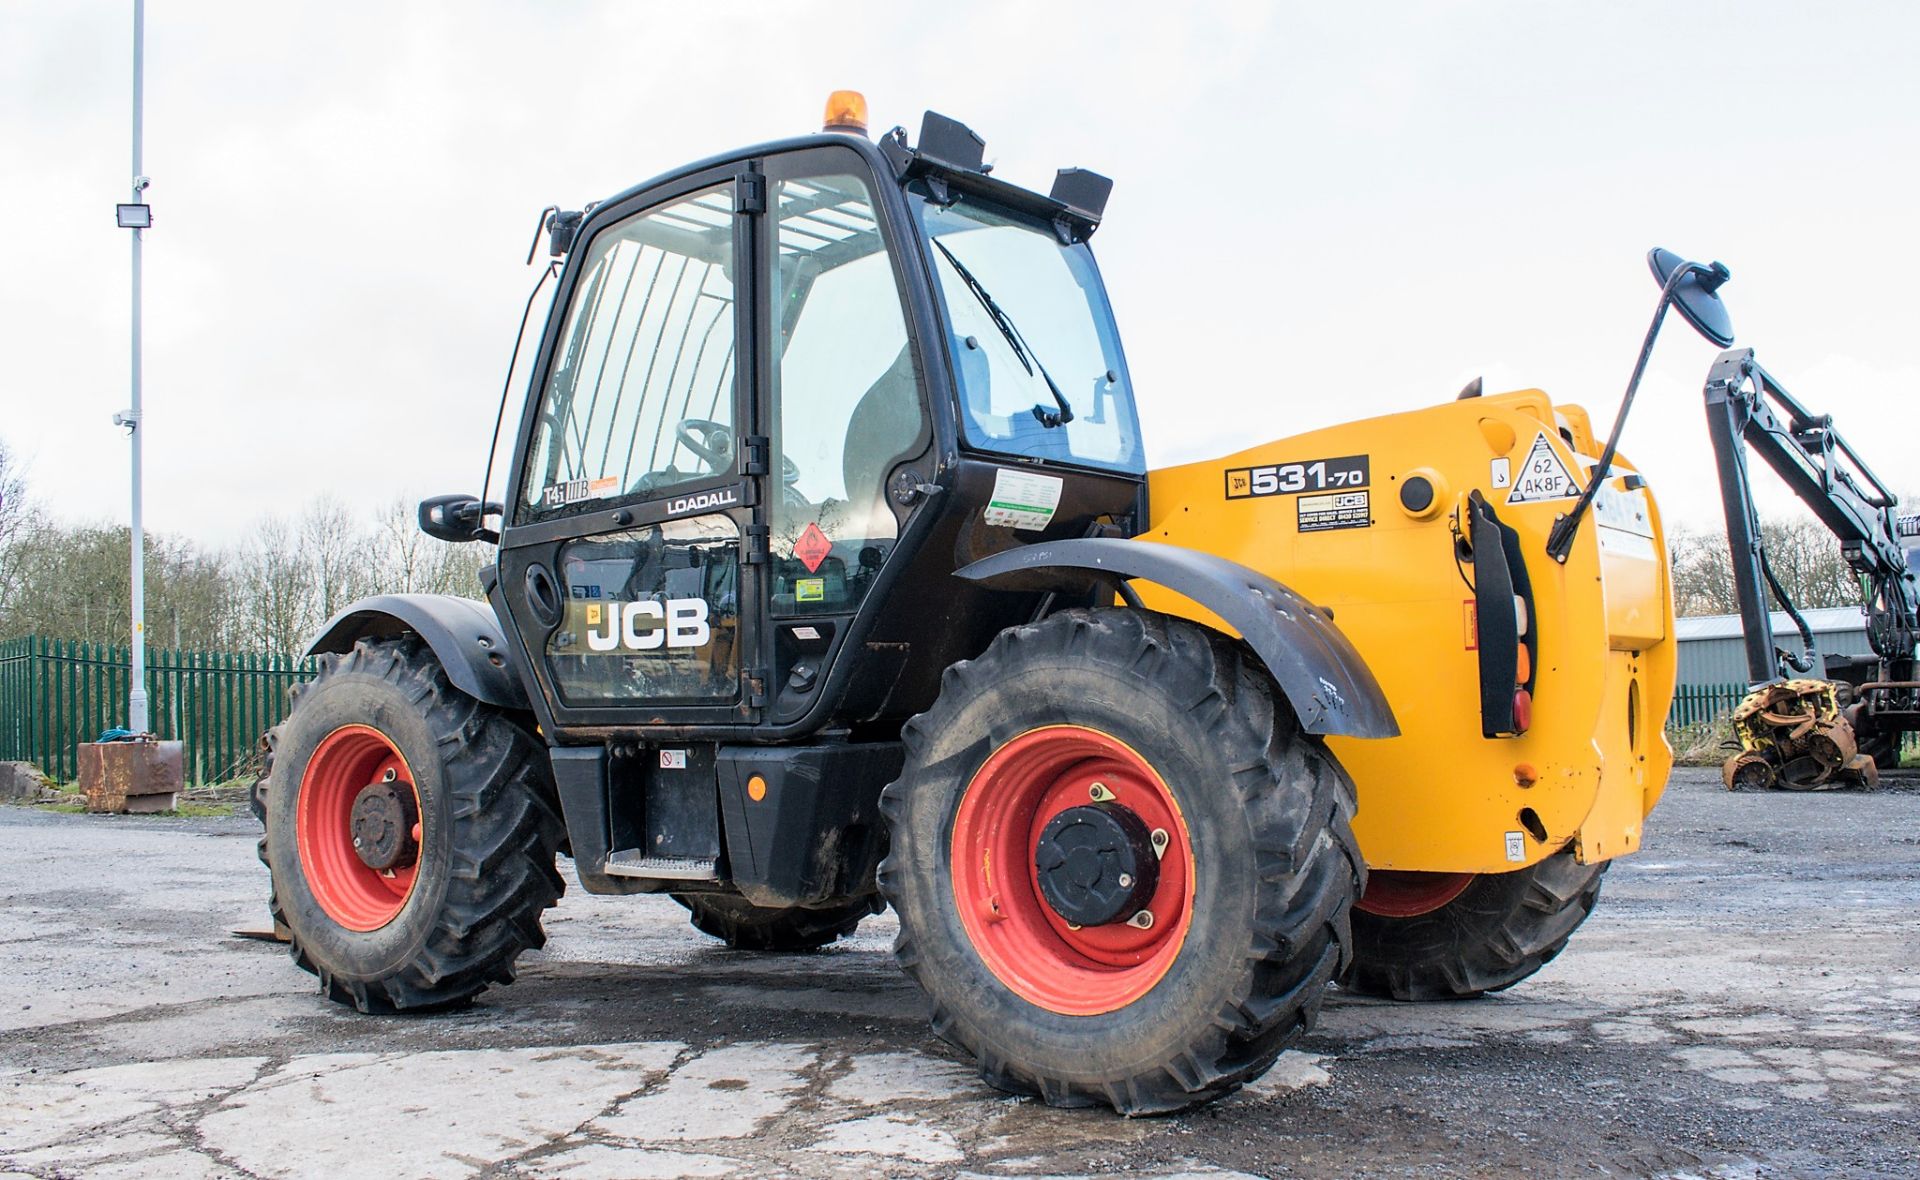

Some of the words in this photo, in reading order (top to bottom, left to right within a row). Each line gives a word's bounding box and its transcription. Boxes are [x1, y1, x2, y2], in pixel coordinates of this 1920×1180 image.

[1533, 459, 1552, 473] 62
[1252, 462, 1363, 494] 531-70
[1525, 476, 1563, 493] AK8F
[668, 491, 737, 514] LOADALL
[1336, 495, 1365, 507] JCB
[587, 598, 710, 651] JCB
